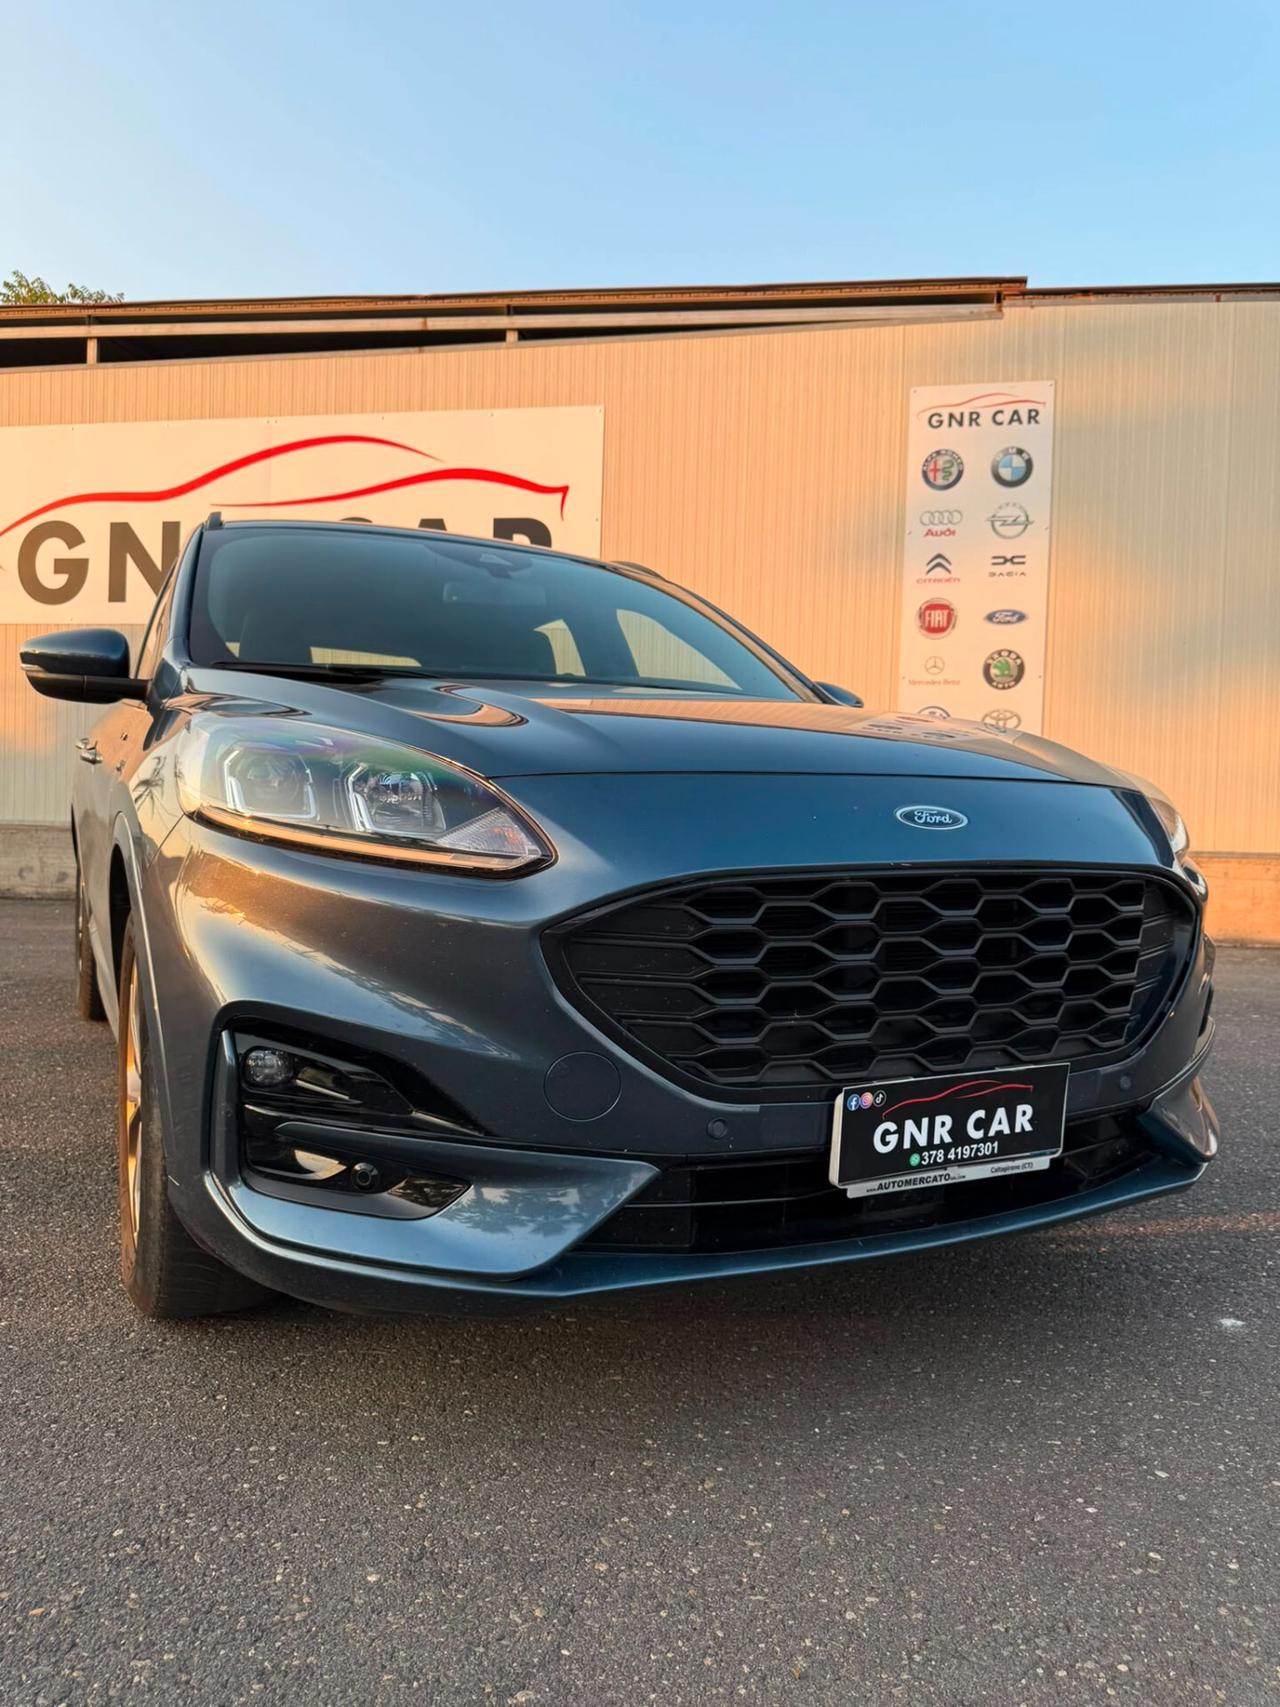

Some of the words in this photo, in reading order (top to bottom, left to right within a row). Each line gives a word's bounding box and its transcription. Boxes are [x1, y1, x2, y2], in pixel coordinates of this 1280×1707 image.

[928, 411, 981, 429] GNR
[991, 409, 1040, 426] CAR
[924, 528, 956, 538] Audi
[18, 520, 181, 605] GN
[925, 609, 949, 628] FIAT
[992, 611, 1021, 623] Ford
[914, 810, 953, 823] Ford
[873, 1115, 953, 1153] GNR
[966, 1104, 1034, 1140] CAR
[921, 1149, 944, 1165] 378
[948, 1141, 999, 1161] 4197301
